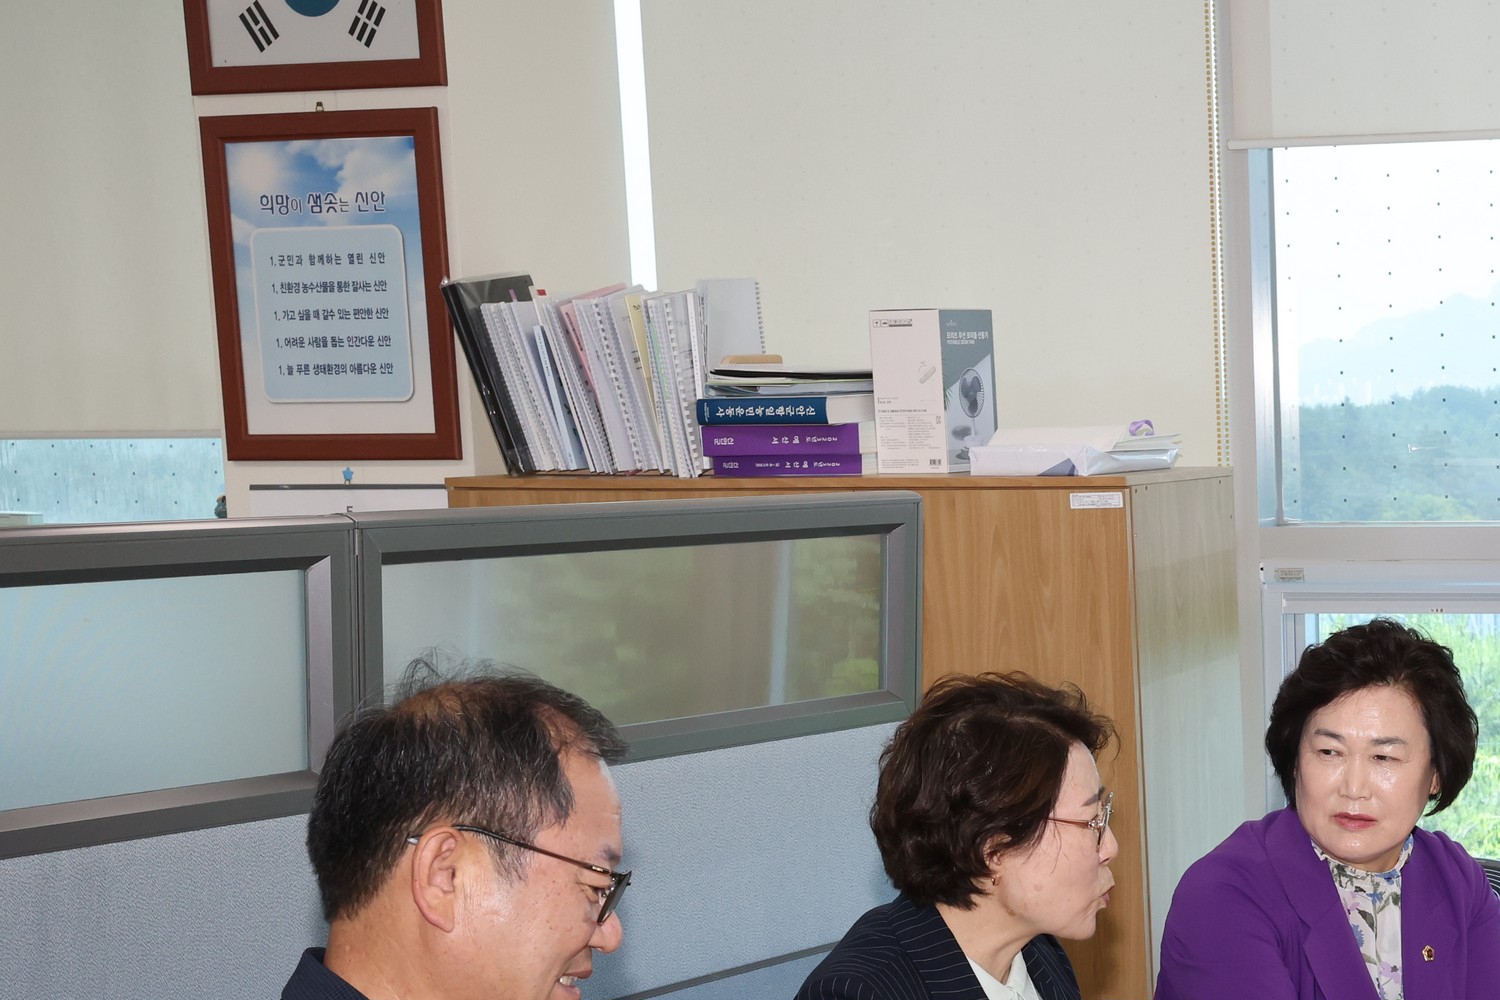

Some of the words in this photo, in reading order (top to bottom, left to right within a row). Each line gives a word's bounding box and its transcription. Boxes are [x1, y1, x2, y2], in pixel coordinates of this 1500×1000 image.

[260, 194, 302, 215] 희망이
[307, 192, 349, 214] 샘솟는
[355, 191, 386, 212] 신안
[308, 253, 342, 266] 함께하는
[347, 252, 364, 265] 열린
[369, 252, 386, 264] 신안
[280, 281, 300, 294] 친환경
[301, 281, 335, 293] 농수산물을
[336, 280, 351, 293] 통한
[351, 280, 371, 293] 잘사는
[373, 280, 387, 292] 신안
[282, 309, 296, 321] 가고
[297, 309, 311, 321] 싶을
[312, 309, 320, 321] 때
[337, 308, 351, 320] 있는
[353, 308, 373, 320] 편안한
[375, 307, 389, 319] 신안
[284, 336, 305, 348] 어려운
[308, 336, 328, 348] 사람을
[330, 336, 345, 348] 돕는
[346, 335, 374, 348] 인간다운
[377, 335, 391, 347] 신안
[286, 364, 294, 375] 늘
[296, 363, 311, 375] 푸른
[312, 363, 347, 375] 생태환경의
[349, 363, 377, 375] 아름다운
[379, 362, 394, 375] 신안
[715, 405, 816, 418] 신안군항일농민운동사
[713, 437, 735, 446] 신안군
